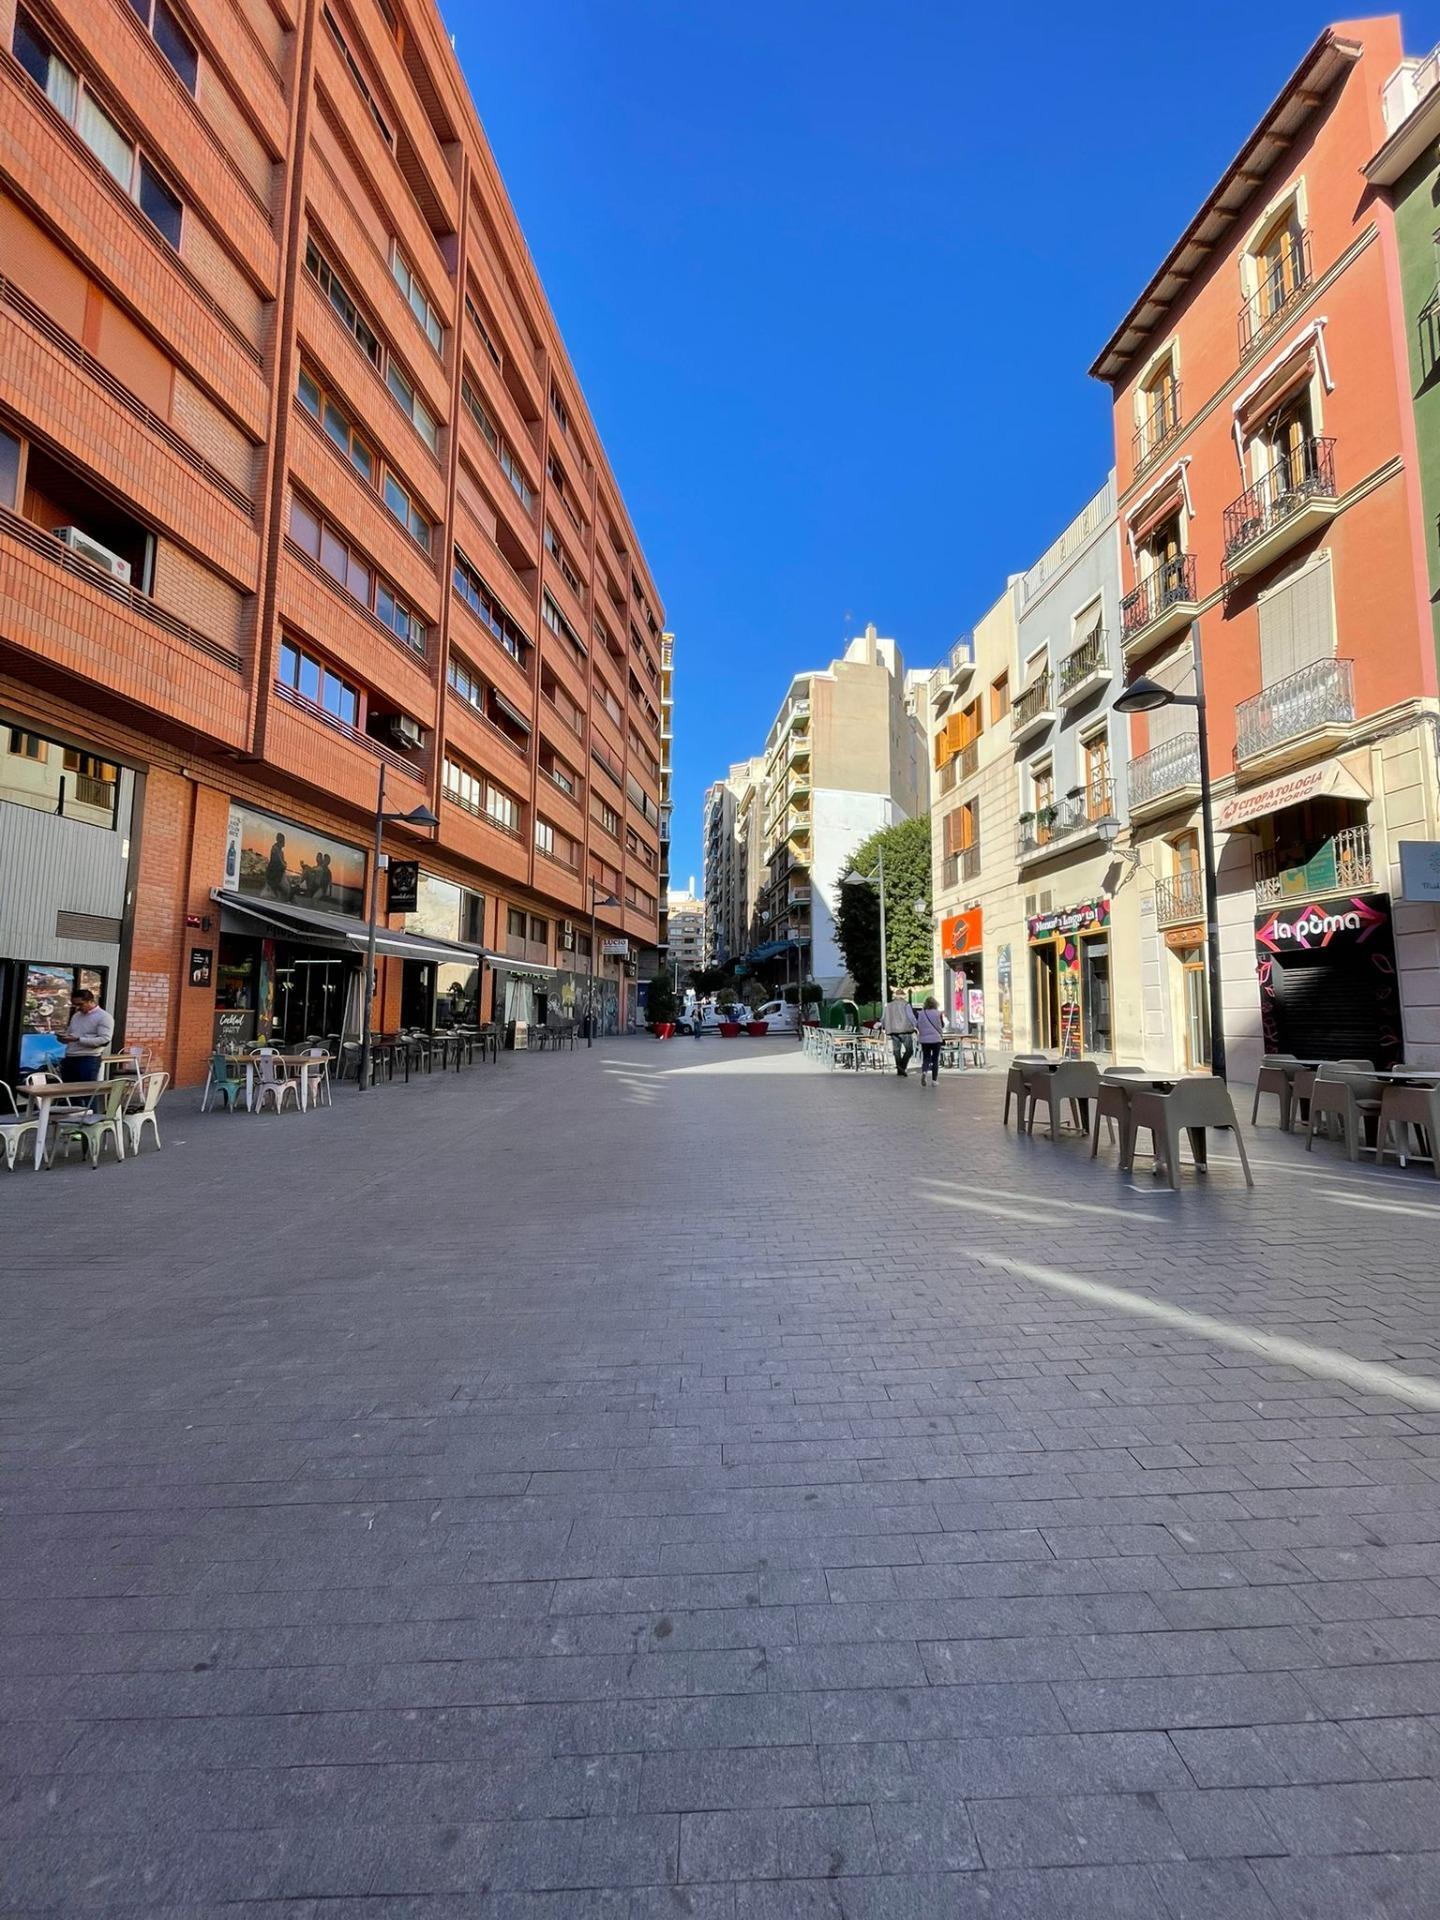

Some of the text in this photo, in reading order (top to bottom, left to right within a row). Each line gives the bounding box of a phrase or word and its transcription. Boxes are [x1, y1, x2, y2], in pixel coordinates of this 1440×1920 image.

[1238, 771, 1323, 810] CITOPATOLOGIA
[1238, 786, 1314, 819] LABORATORIO
[1273, 919, 1292, 940] la
